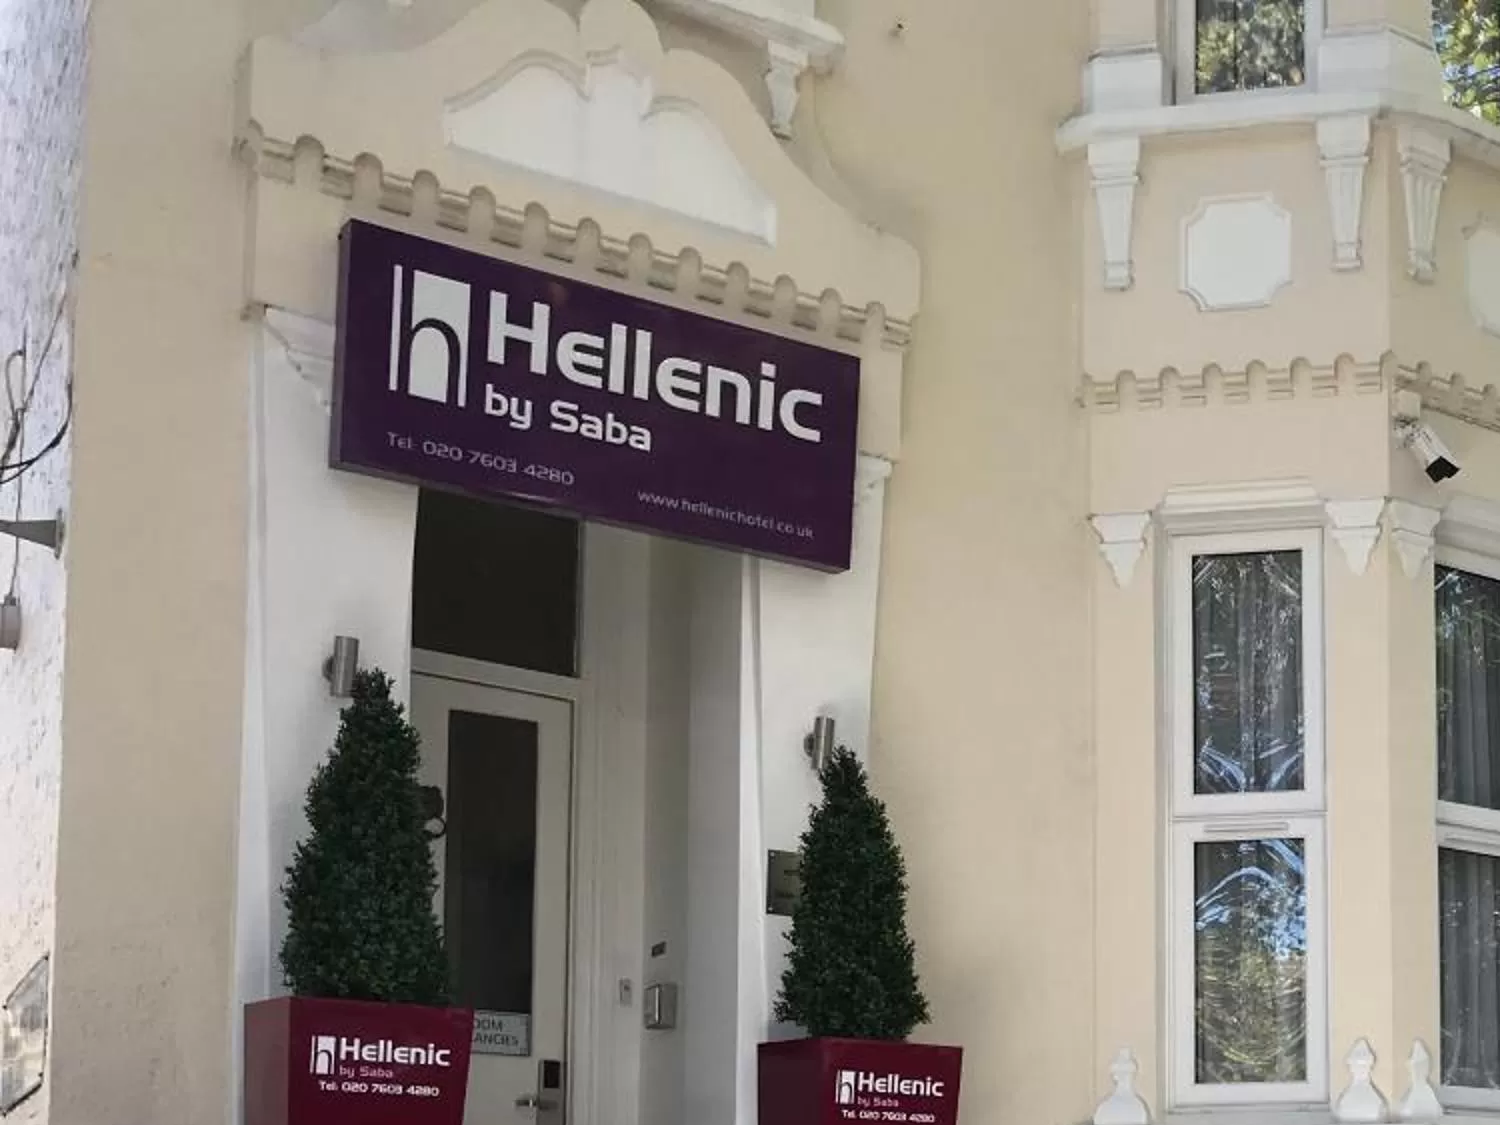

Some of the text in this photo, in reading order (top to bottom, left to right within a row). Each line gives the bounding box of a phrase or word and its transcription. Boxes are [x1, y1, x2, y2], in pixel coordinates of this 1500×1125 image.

[486, 290, 825, 442] Hellenic
[484, 383, 652, 452] by Saba
[423, 441, 463, 462] 020
[467, 450, 518, 474] 7603
[523, 464, 576, 486] 4280
[339, 1037, 451, 1067] Hellenic
[339, 1065, 394, 1078] by Saba
[858, 1071, 945, 1097] Hellenic
[341, 1081, 369, 1093] 020
